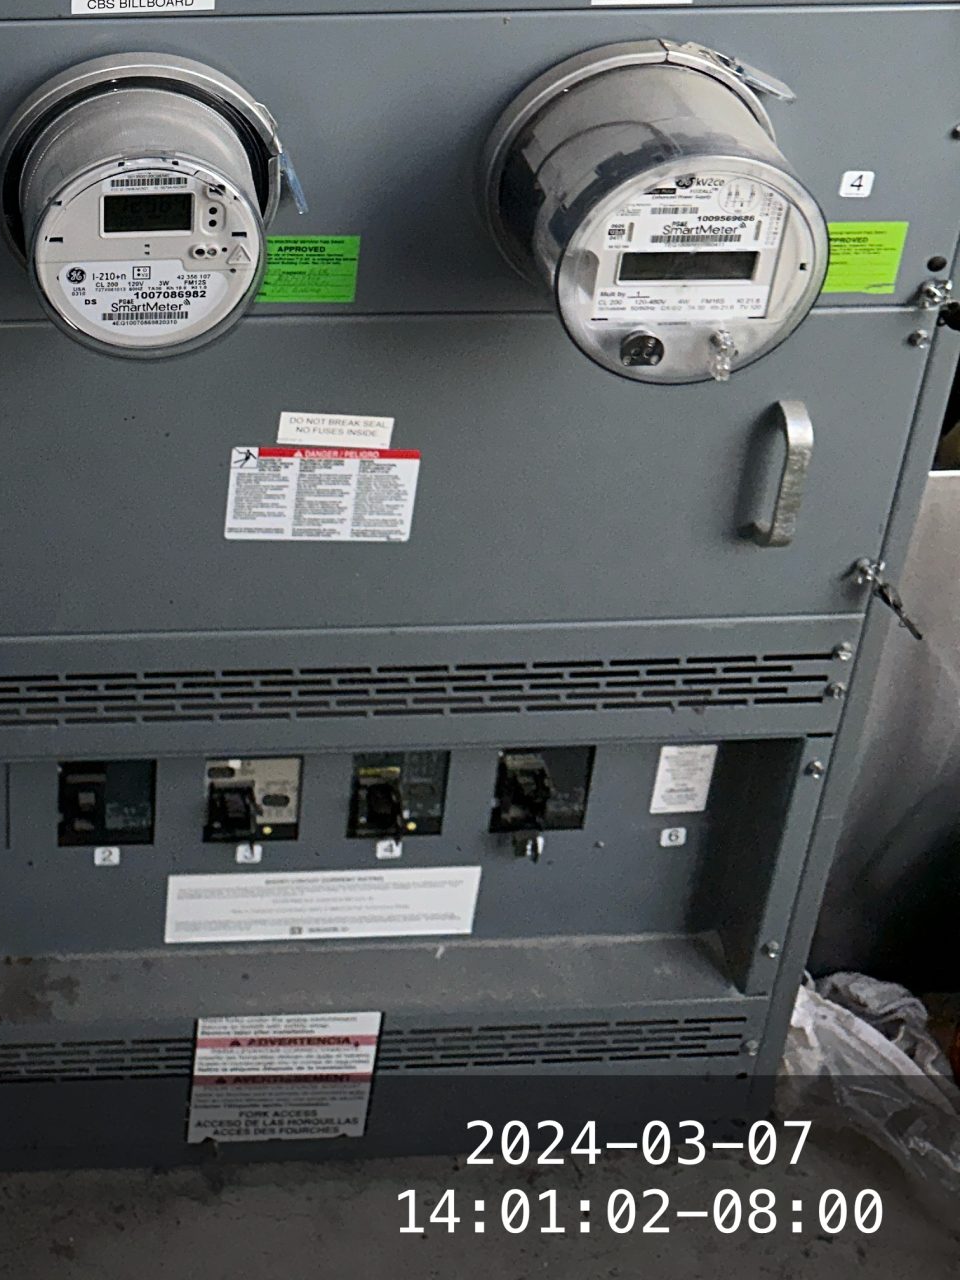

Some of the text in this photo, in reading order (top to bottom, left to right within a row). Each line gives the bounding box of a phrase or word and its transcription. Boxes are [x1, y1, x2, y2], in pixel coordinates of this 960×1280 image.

[850, 173, 864, 191] 4
[662, 224, 739, 235] SmartMeter
[134, 291, 207, 299] 1007086982
[111, 303, 183, 312] SmartMeter
[289, 417, 386, 428] DO NOT BREAK SEAL
[296, 426, 378, 437] NO FUSES INSIDE
[304, 450, 380, 459] DANGER PELIGRO
[668, 829, 679, 843] 6
[101, 849, 113, 863] 2
[247, 1036, 351, 1047] ADVERTENCIA
[239, 1109, 318, 1118] FORK ACCESS
[195, 1120, 242, 1129] ACCESO
[244, 1120, 261, 1128] DE
[263, 1119, 284, 1127] LAS
